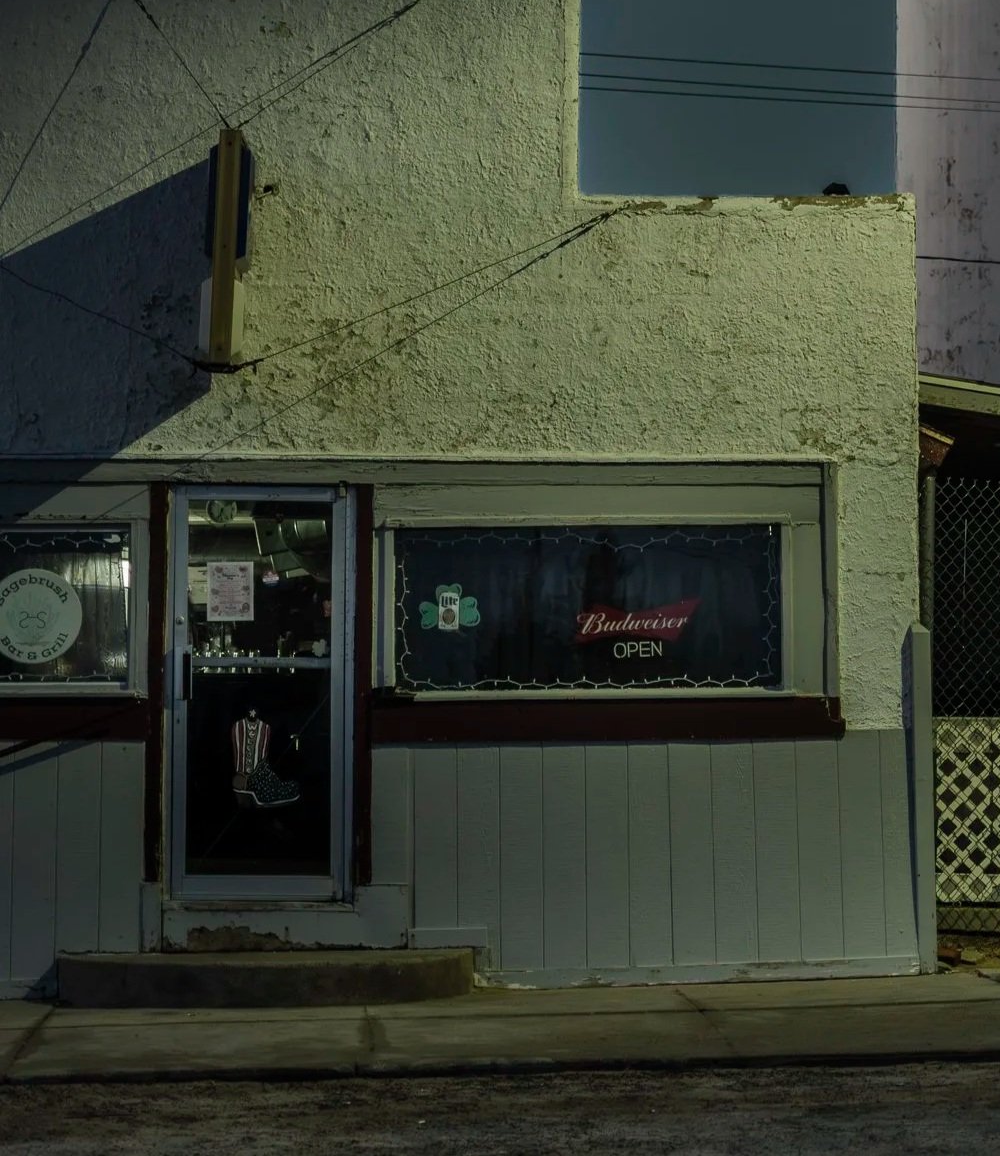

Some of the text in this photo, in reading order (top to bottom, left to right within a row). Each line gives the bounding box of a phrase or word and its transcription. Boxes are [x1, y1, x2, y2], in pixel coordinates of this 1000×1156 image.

[441, 595, 459, 608] Lite
[576, 612, 688, 635] Budweiser
[0, 633, 68, 660] Bar & Grill
[613, 640, 663, 659] OPEN
